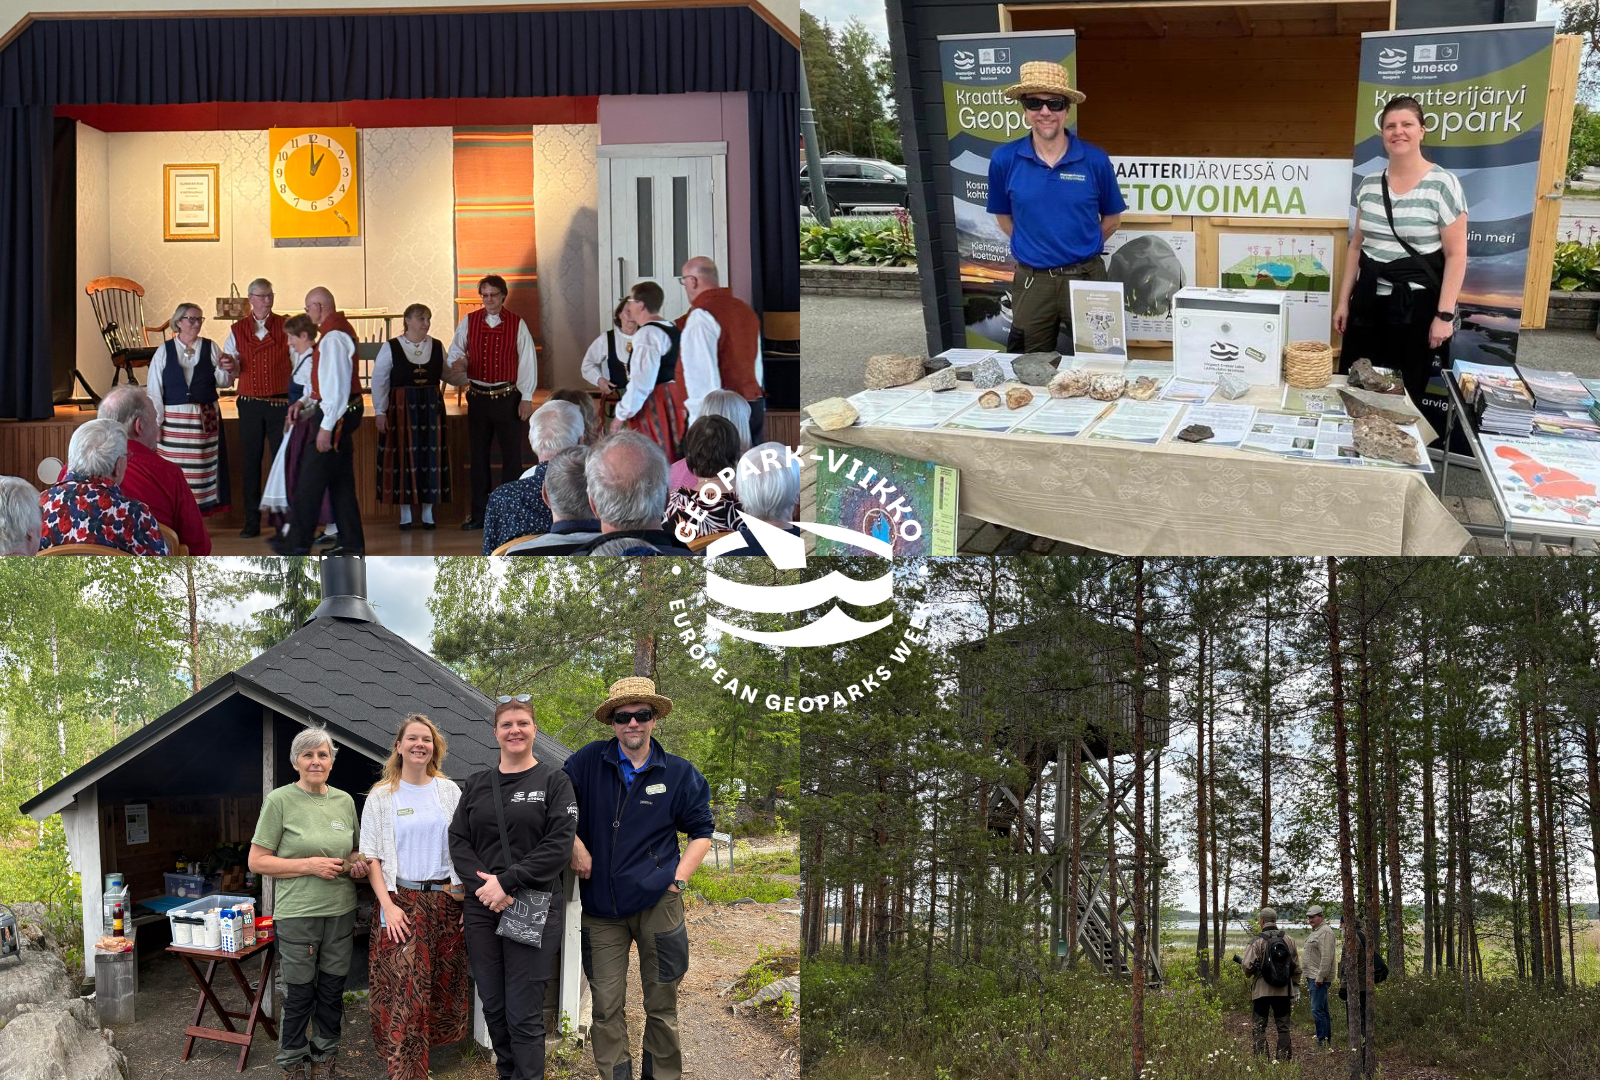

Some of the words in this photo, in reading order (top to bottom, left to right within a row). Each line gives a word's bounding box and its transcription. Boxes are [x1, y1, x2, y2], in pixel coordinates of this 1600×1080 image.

[980, 66, 1012, 75] unesco
[1412, 63, 1458, 73] unesco
[291, 138, 299, 148] 11
[308, 134, 318, 144] 12
[327, 138, 332, 148] 1
[278, 151, 288, 161] 10
[338, 149, 345, 159] 2
[276, 168, 283, 178] 9
[342, 167, 349, 177] 3
[1112, 160, 1276, 181] AATTERIJÄRVESSÄ
[1281, 164, 1310, 181] ON
[279, 184, 287, 194] 8
[338, 184, 346, 193] 4
[293, 197, 300, 207] 7
[310, 201, 318, 211] 6
[327, 196, 335, 206] 5
[1485, 233, 1516, 243] meri
[971, 241, 1004, 254] Kiehtova
[972, 250, 1006, 263] koettava
